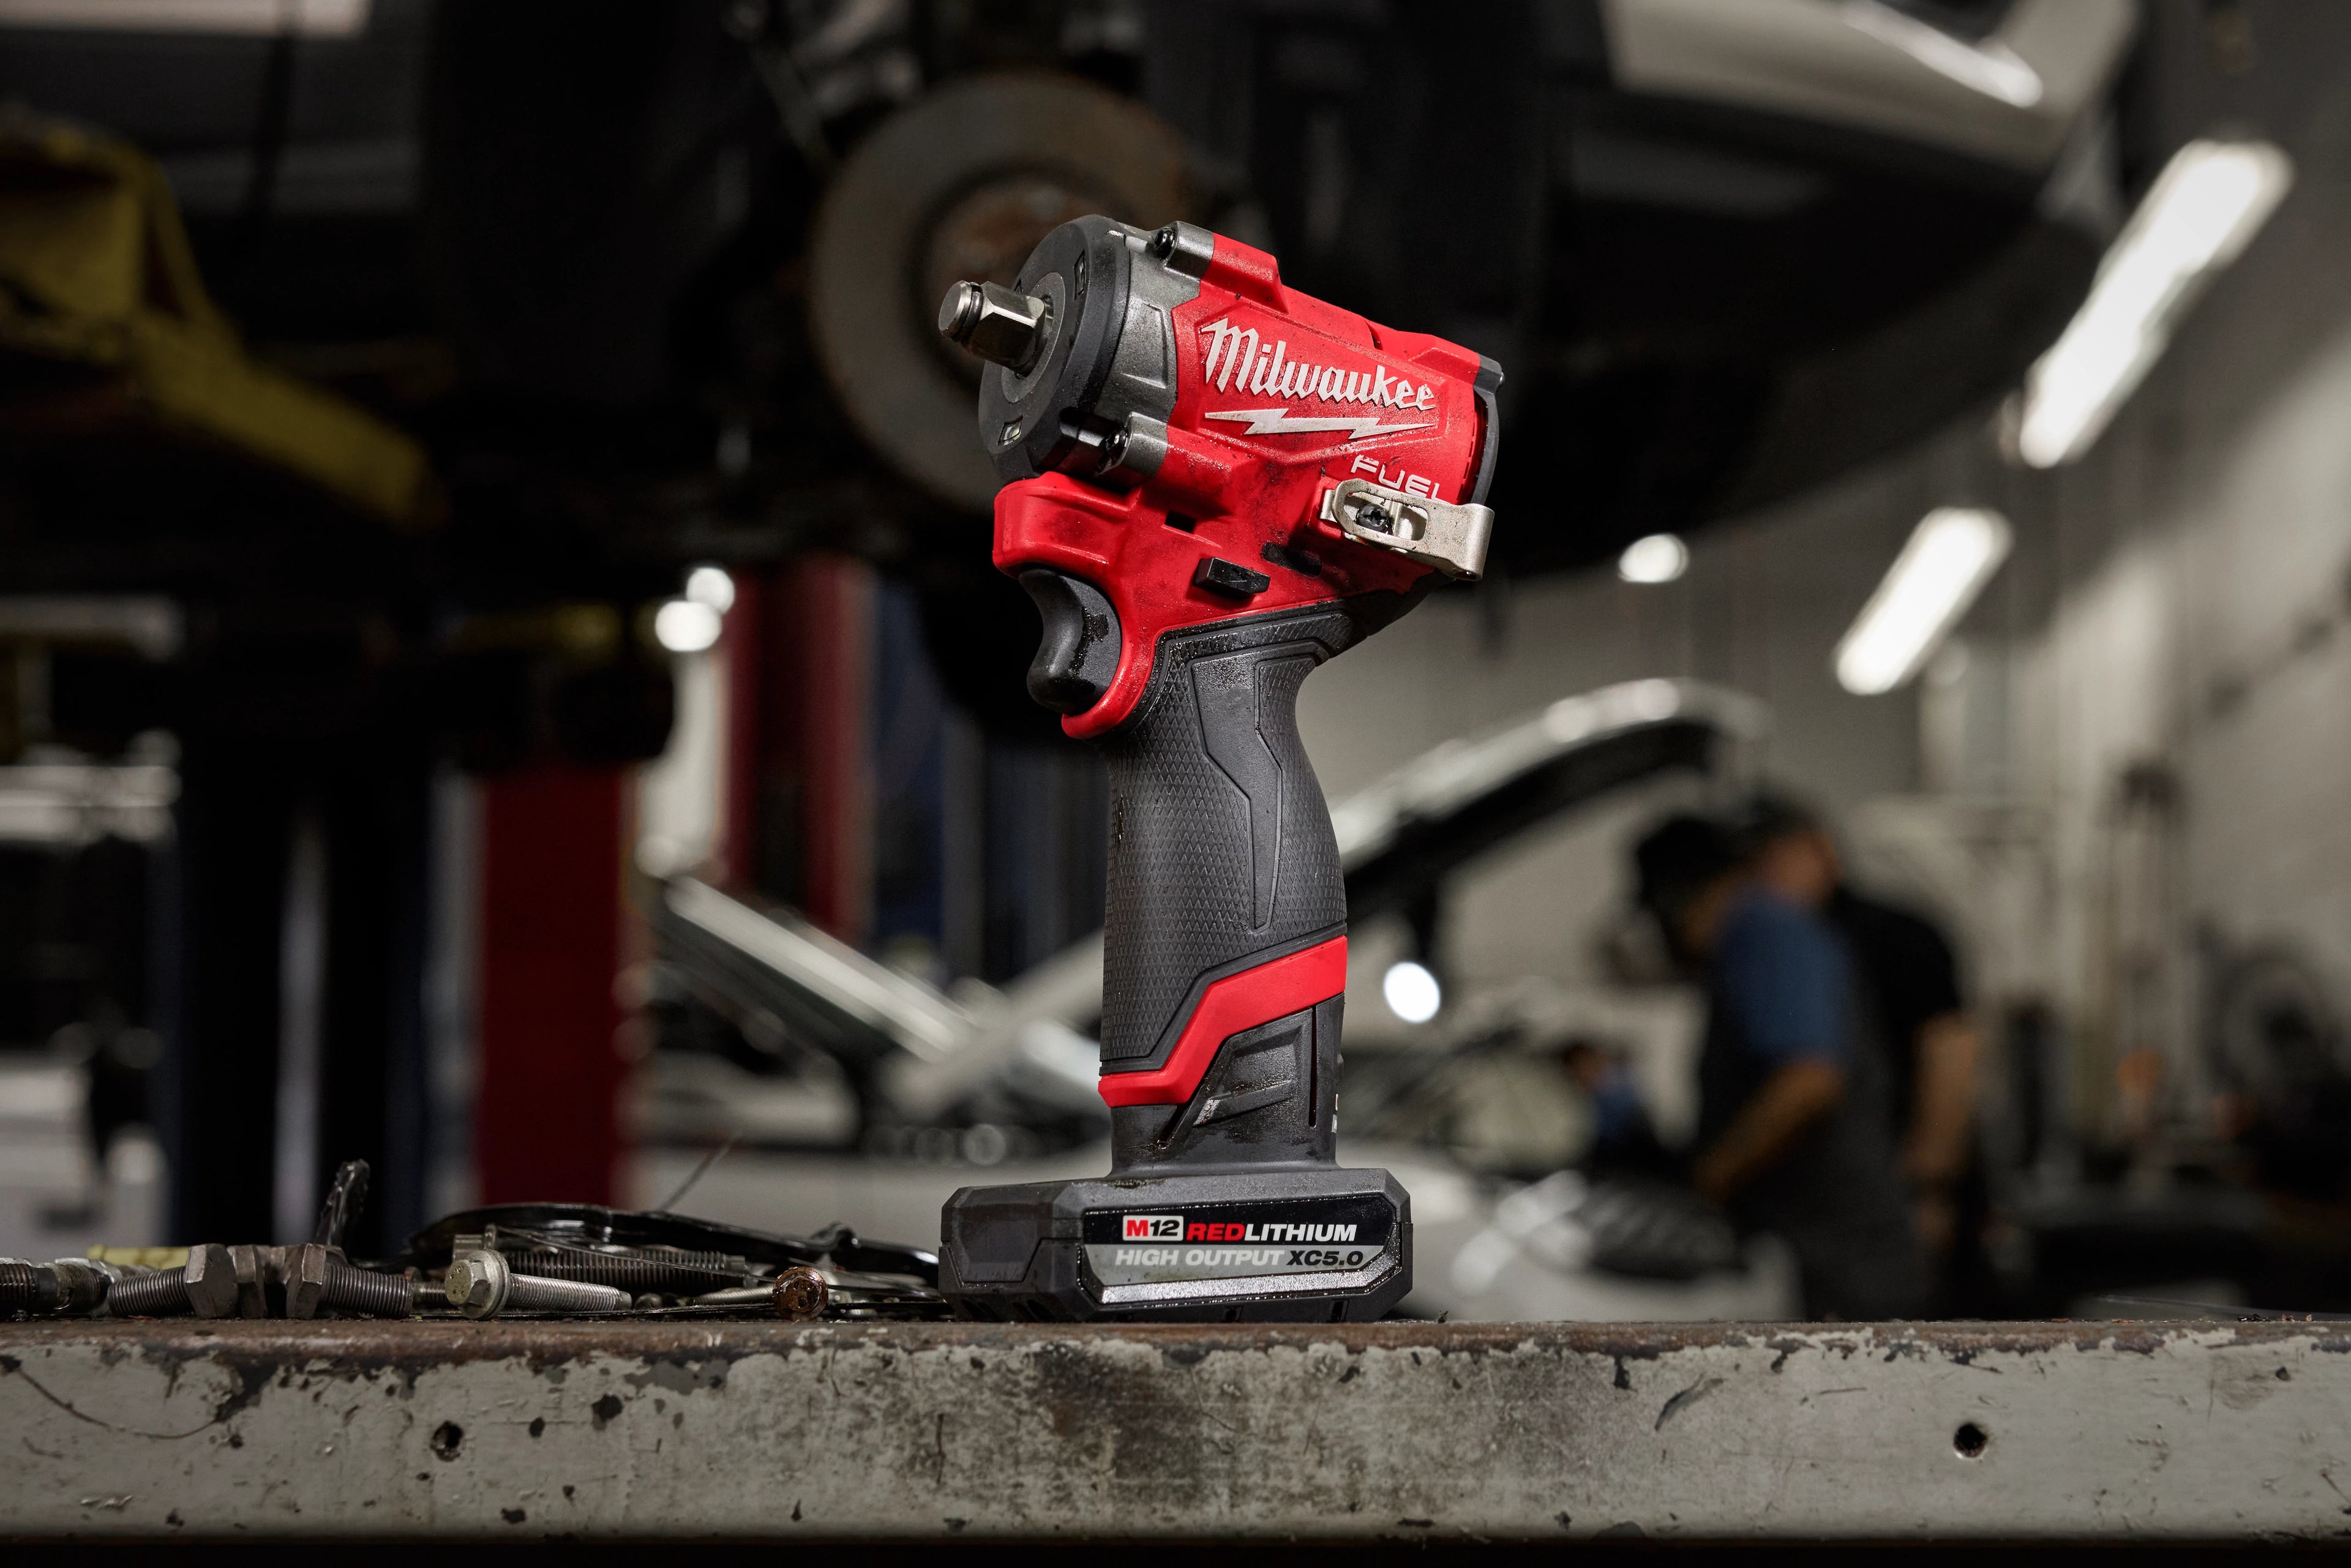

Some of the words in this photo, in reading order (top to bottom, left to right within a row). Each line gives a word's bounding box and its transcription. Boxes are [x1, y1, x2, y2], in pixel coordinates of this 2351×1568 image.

[1202, 318, 1436, 410] Milwaukee
[1351, 454, 1451, 505] FUEL
[1126, 1219, 1180, 1237] M12
[1187, 1223, 1357, 1242] REDLITHIUM
[1115, 1250, 1179, 1266] HIGH
[1185, 1249, 1285, 1266] OUTPUT
[1286, 1250, 1364, 1266] XC5.0
